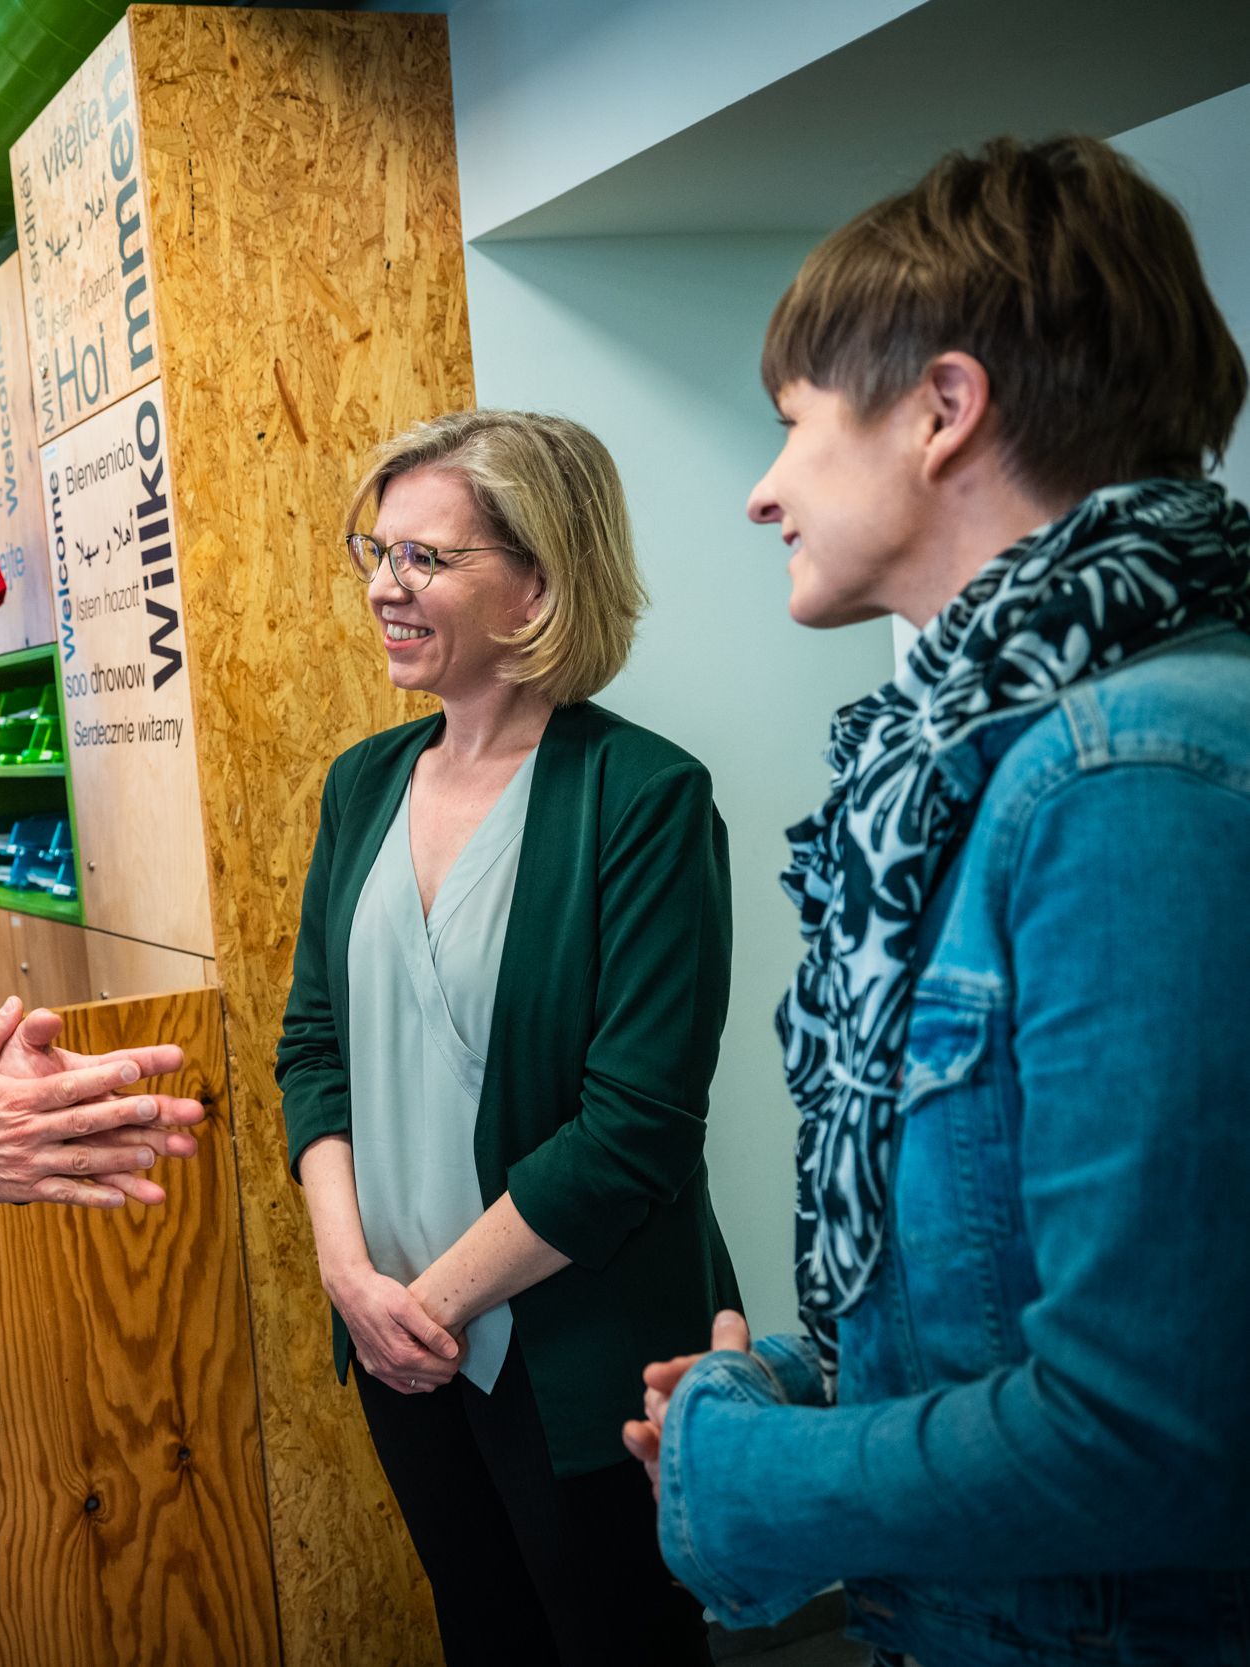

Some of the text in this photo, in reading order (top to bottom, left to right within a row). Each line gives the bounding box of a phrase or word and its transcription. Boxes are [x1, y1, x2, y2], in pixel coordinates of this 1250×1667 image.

[53, 322, 110, 422] Hoi
[66, 438, 135, 496] Bienvenido
[49, 470, 76, 663] Welcome
[103, 582, 140, 616] hozott
[66, 661, 146, 699] soo dhowow
[74, 714, 183, 748] Serdecznie witamy
